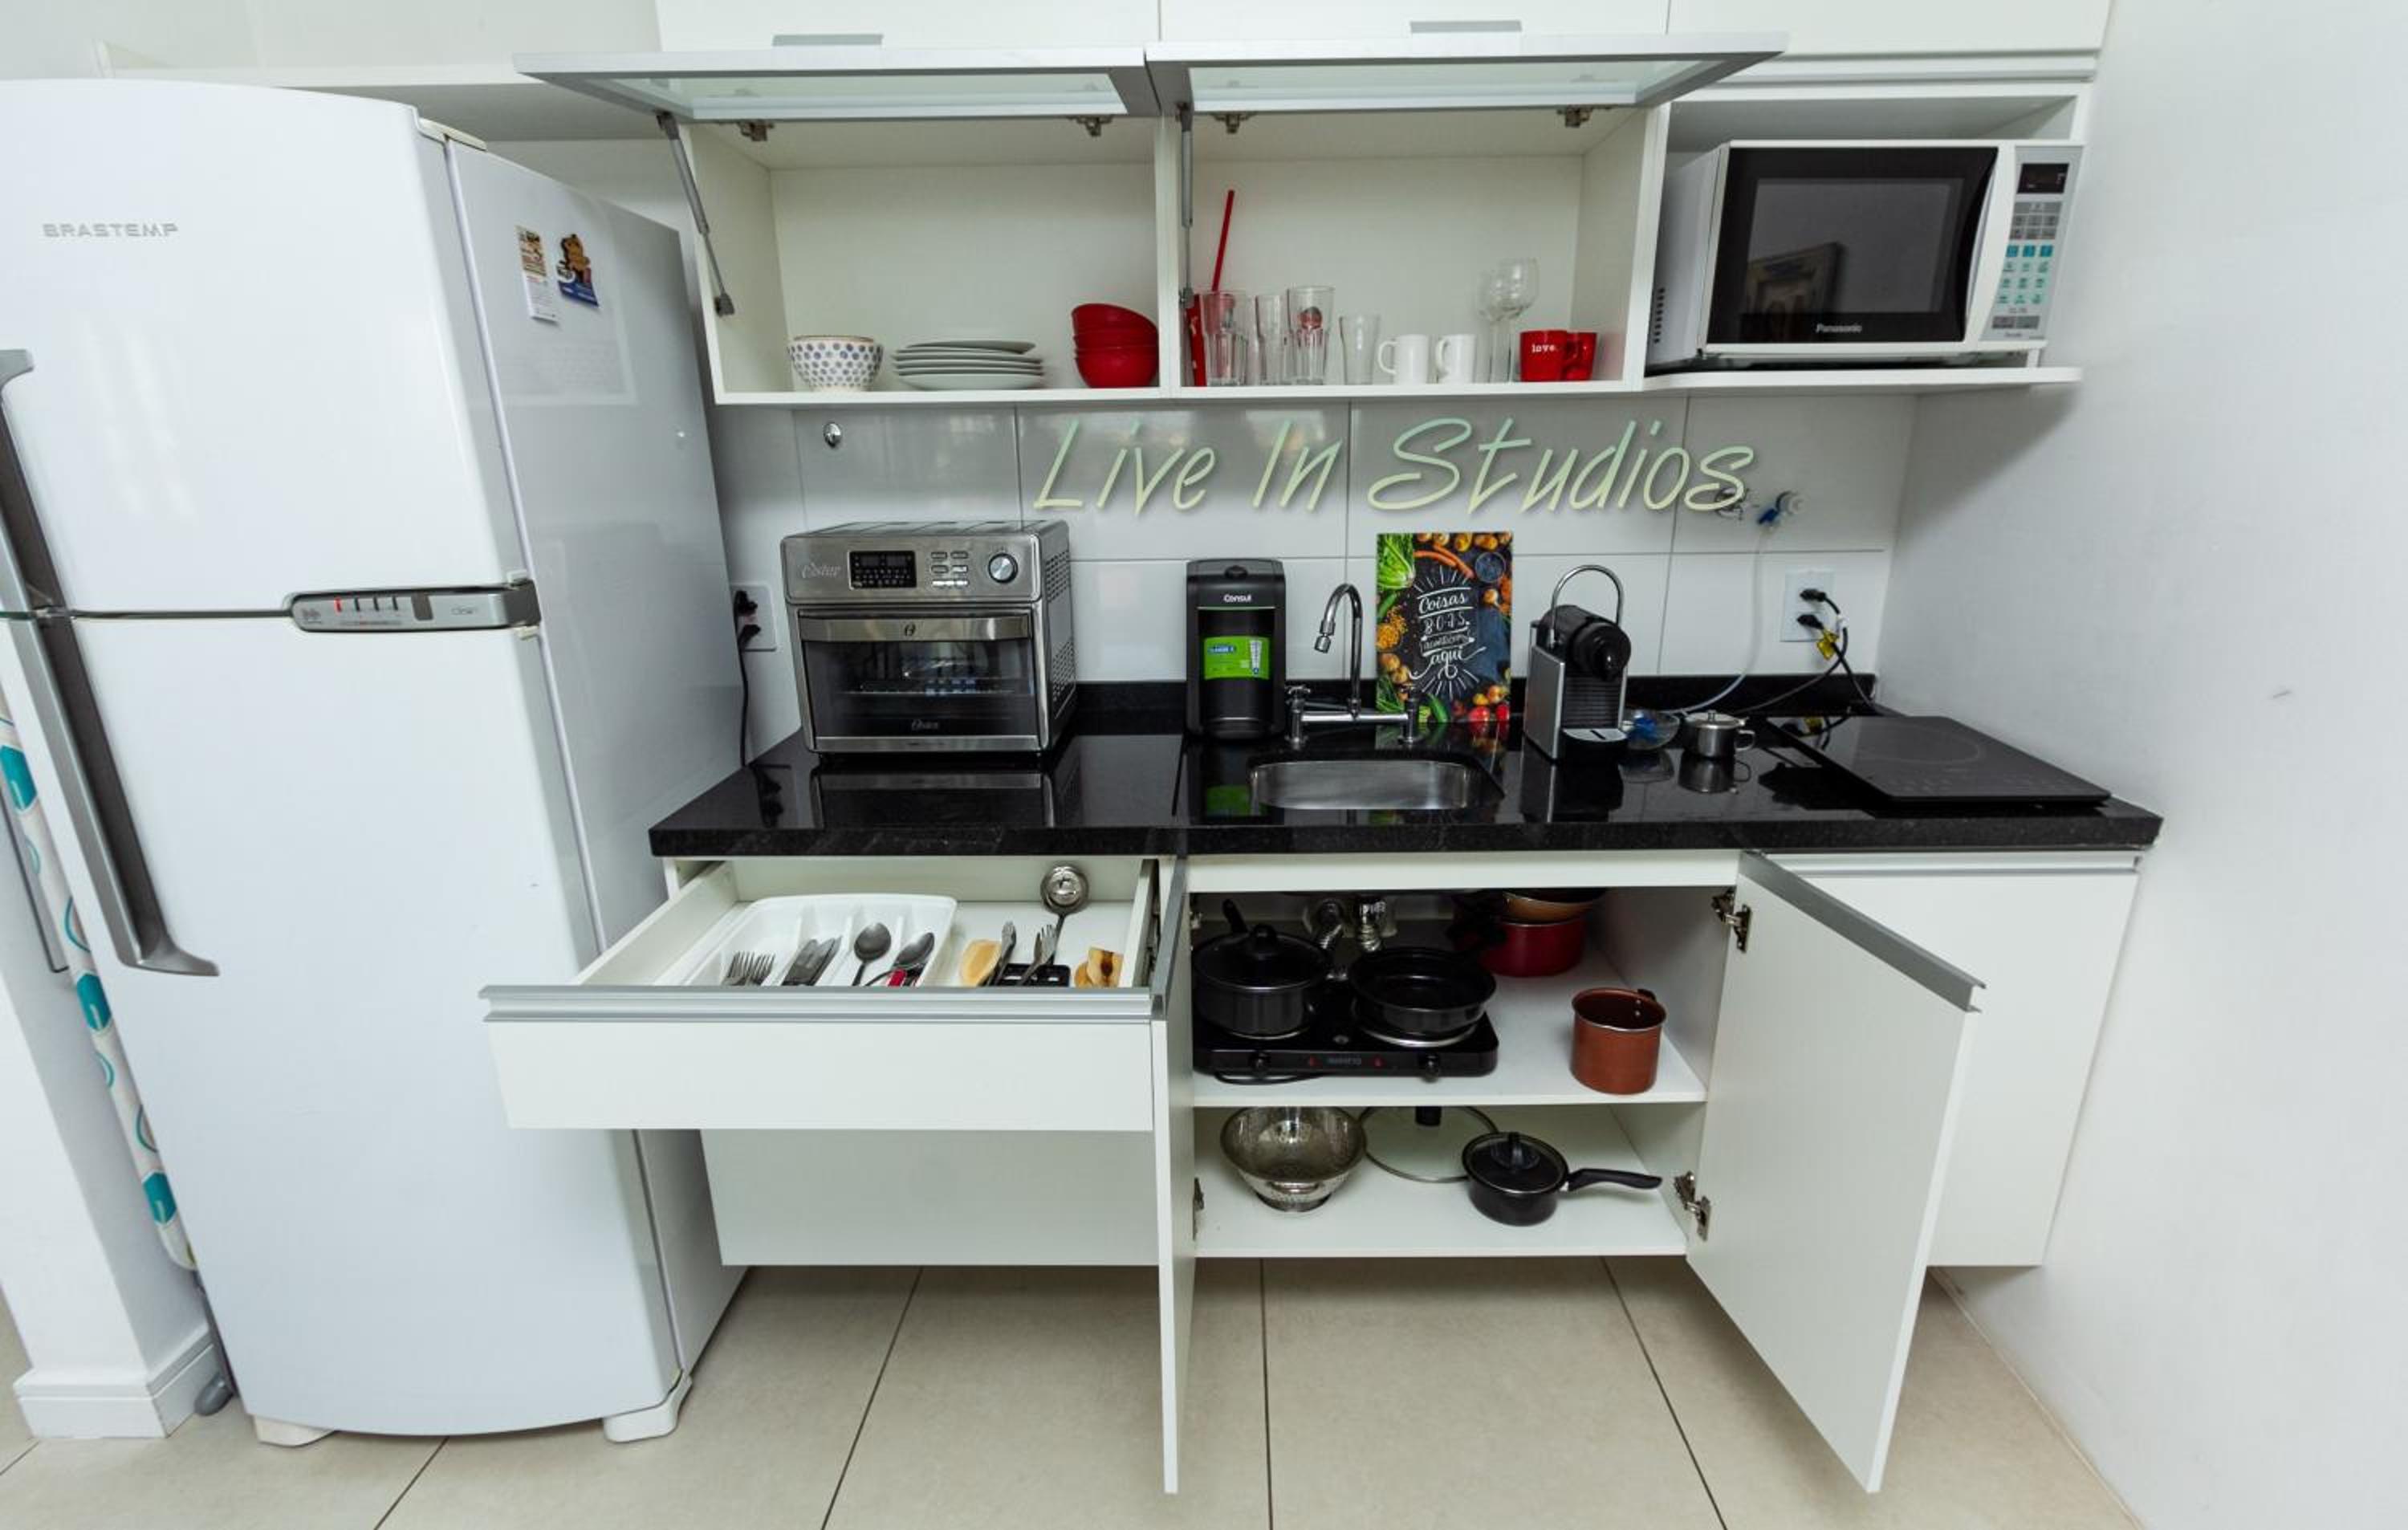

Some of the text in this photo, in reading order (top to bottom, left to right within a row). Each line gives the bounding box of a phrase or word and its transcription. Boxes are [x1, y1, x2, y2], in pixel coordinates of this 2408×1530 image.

[42, 223, 179, 238] BRASTEMP
[1816, 323, 1862, 334] Panasonic
[1223, 593, 1252, 603] Consul
[1418, 592, 1466, 614] Coisas
